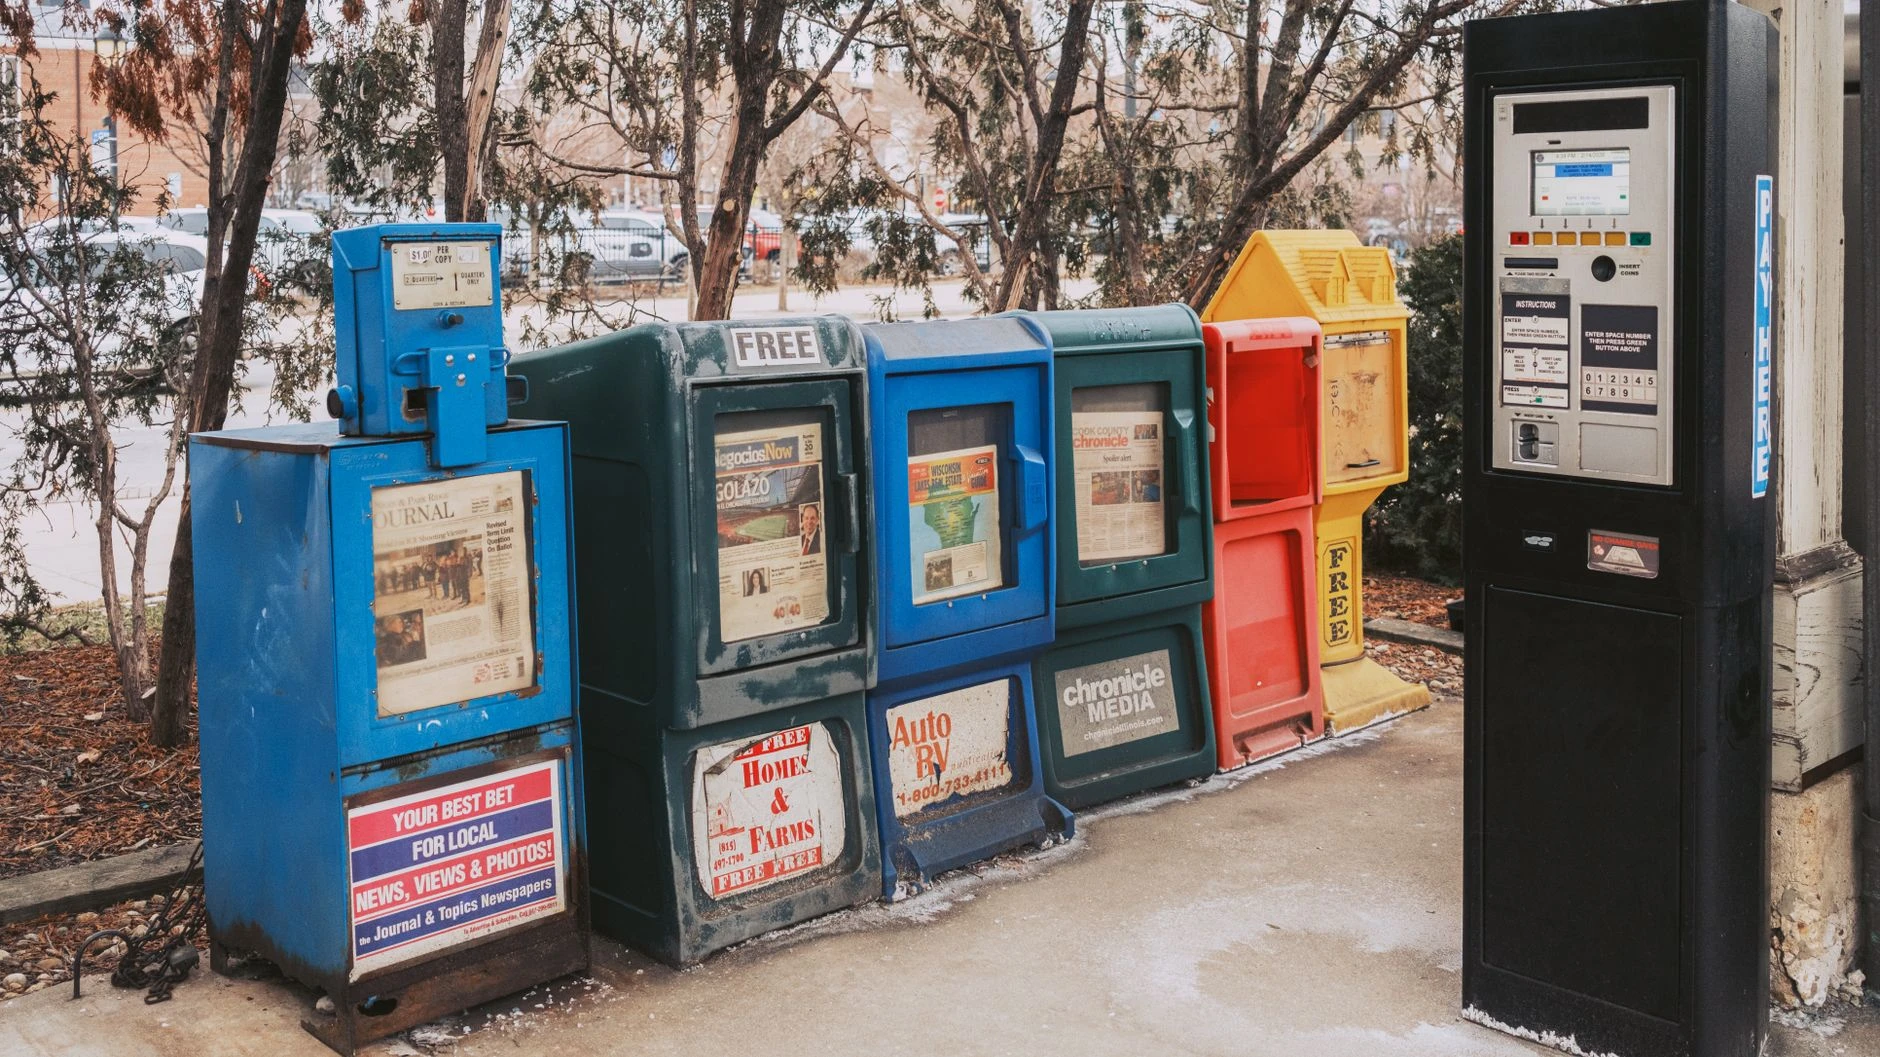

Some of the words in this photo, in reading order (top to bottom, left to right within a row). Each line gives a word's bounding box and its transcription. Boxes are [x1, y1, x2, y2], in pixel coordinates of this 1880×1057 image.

[434, 255, 452, 264] COPY
[437, 245, 449, 254] PER
[1759, 189, 1771, 308] PAY
[412, 275, 436, 283] QUARTERS
[1516, 300, 1556, 309] INSTRUCTIONS
[735, 330, 816, 361] FREE
[1585, 373, 1591, 382] 0
[1598, 374, 1602, 382] 1
[1610, 375, 1616, 383] 2
[1623, 375, 1628, 384] 3
[1635, 376, 1641, 384] 4
[1648, 377, 1653, 386] 5
[1585, 386, 1591, 395] 6
[1598, 387, 1603, 396] 7
[1610, 388, 1615, 397] 8
[1623, 389, 1628, 397] 9
[1757, 326, 1770, 482] HERE
[1073, 434, 1128, 448] chronicle
[1098, 426, 1129, 435] COUNTY
[931, 462, 961, 476] WISCONSIN
[1121, 454, 1132, 462] alert
[716, 477, 770, 502] GOLAZO
[945, 474, 962, 486] ESTATE
[373, 501, 455, 529] OURNAL
[486, 520, 507, 529] Revised
[486, 529, 500, 537] Term
[500, 527, 514, 535] Limit
[487, 536, 511, 546] Question
[487, 545, 496, 553] On
[497, 543, 512, 552] Ballot
[1328, 546, 1349, 642] FREE
[1063, 664, 1165, 707] chronicle
[1088, 690, 1156, 723] MEDIA
[762, 728, 807, 752] FREE
[893, 711, 951, 751] Auto
[742, 754, 812, 789] HOMES
[915, 739, 950, 780] RV
[392, 806, 438, 832] YOUR
[442, 793, 482, 820] BEST
[485, 784, 515, 809] BET
[771, 786, 790, 815] &
[412, 835, 445, 861] FOR
[448, 821, 498, 851] LOCAL
[718, 840, 737, 855] (815)
[749, 819, 815, 855] FARMS
[713, 852, 745, 871] 497-1700
[718, 864, 766, 892] FREE
[772, 849, 818, 874] FREE
[356, 880, 411, 913] NEWS,
[414, 863, 466, 894] VIEWS
[470, 859, 483, 879] &
[486, 839, 553, 873] PHOTOS!
[359, 935, 371, 946] the
[374, 914, 422, 942] Journal
[425, 910, 435, 924] &
[438, 898, 478, 921] Topics
[481, 876, 552, 908] Newspapers
